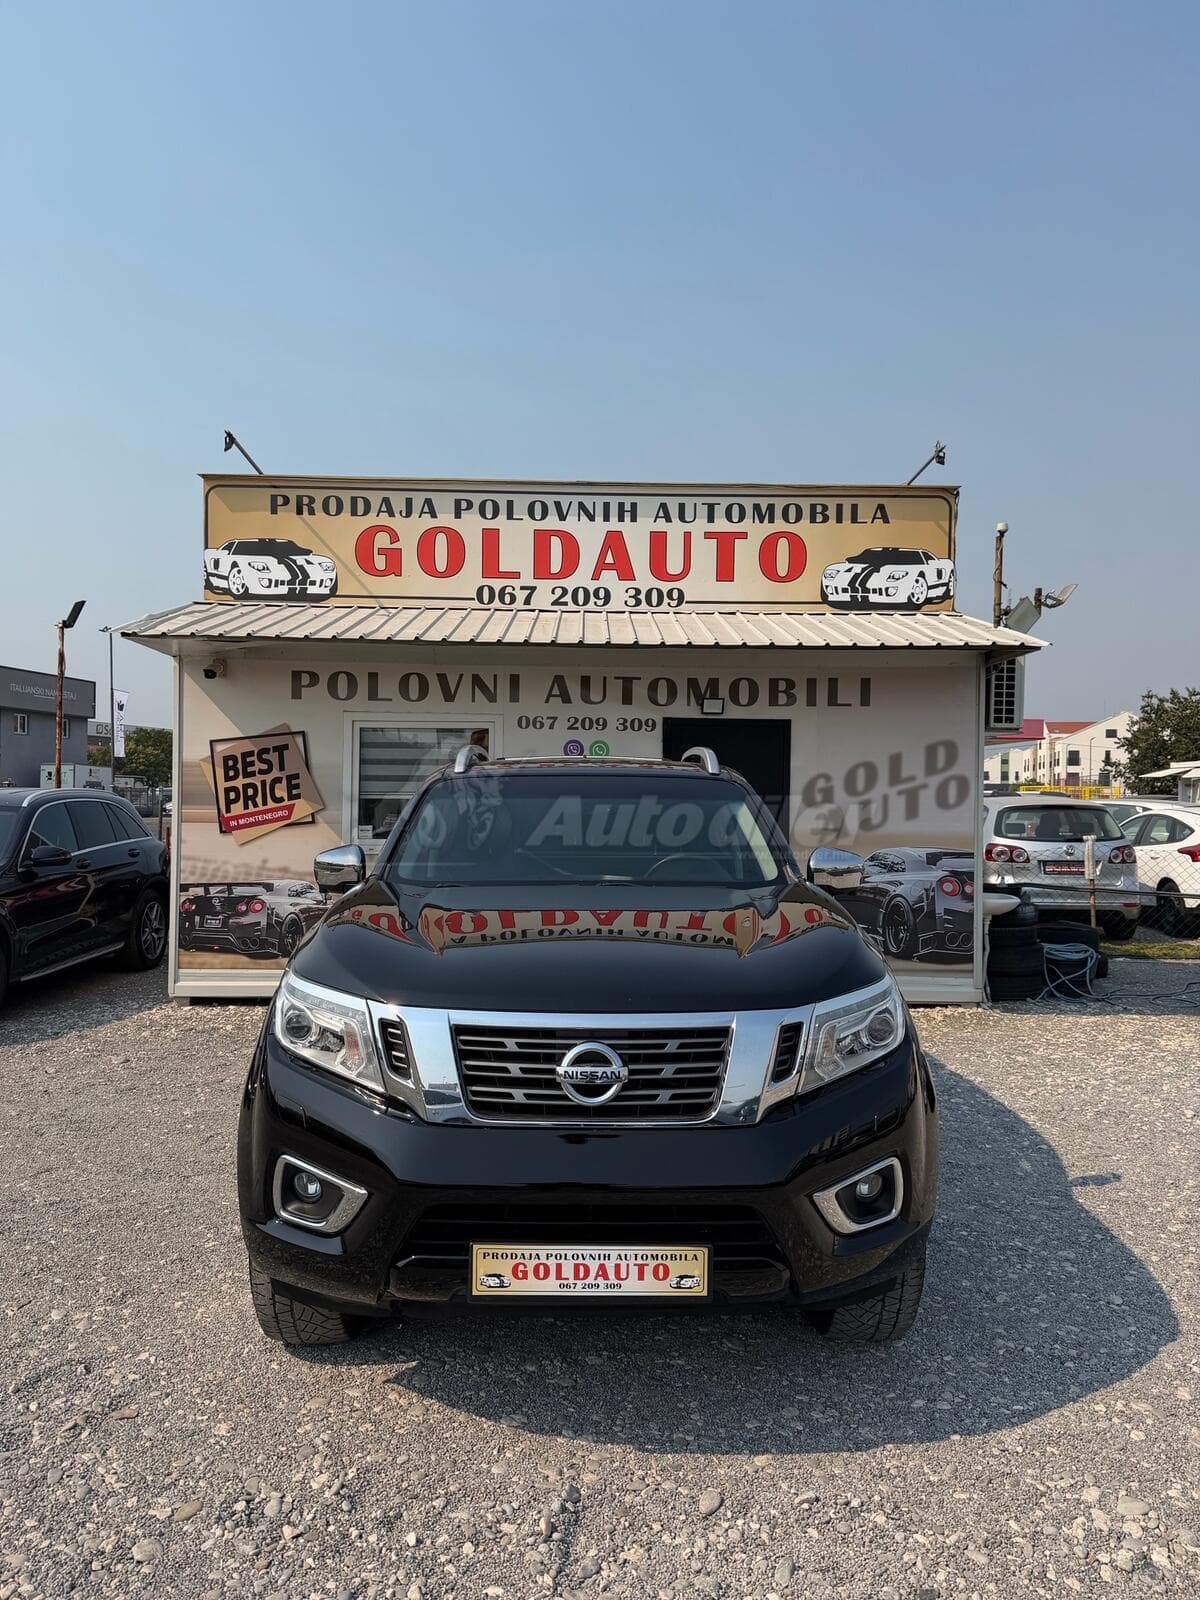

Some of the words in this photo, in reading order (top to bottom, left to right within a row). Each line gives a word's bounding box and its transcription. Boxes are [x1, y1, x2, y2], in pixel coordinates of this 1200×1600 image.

[270, 494, 438, 519] PRODAJA
[454, 498, 638, 523] POLOVNIH
[653, 502, 890, 524] AUTOMOBILA
[354, 524, 808, 583] GOLDAUTO
[475, 584, 538, 606] 067
[550, 585, 612, 607] 209
[624, 586, 686, 608] 309
[290, 669, 521, 704] POLOVNI
[544, 674, 872, 708] AUTOMOBILI
[516, 715, 559, 731] 067
[566, 716, 608, 732] 209
[615, 716, 657, 732] 309
[222, 743, 290, 783] BEST
[801, 739, 960, 807] GOLD
[223, 772, 302, 814] PRICE
[238, 809, 289, 825] MONTENEGRO
[563, 1069, 622, 1081] NISSAN
[482, 1251, 541, 1261] PRODAJA
[545, 1252, 611, 1261] POLOVNIH
[616, 1252, 699, 1262] AUTOMOBILA
[510, 1262, 670, 1281] GOLDAUTO
[558, 1282, 577, 1290] 067
[581, 1282, 600, 1290] 209
[602, 1282, 622, 1290] 309
